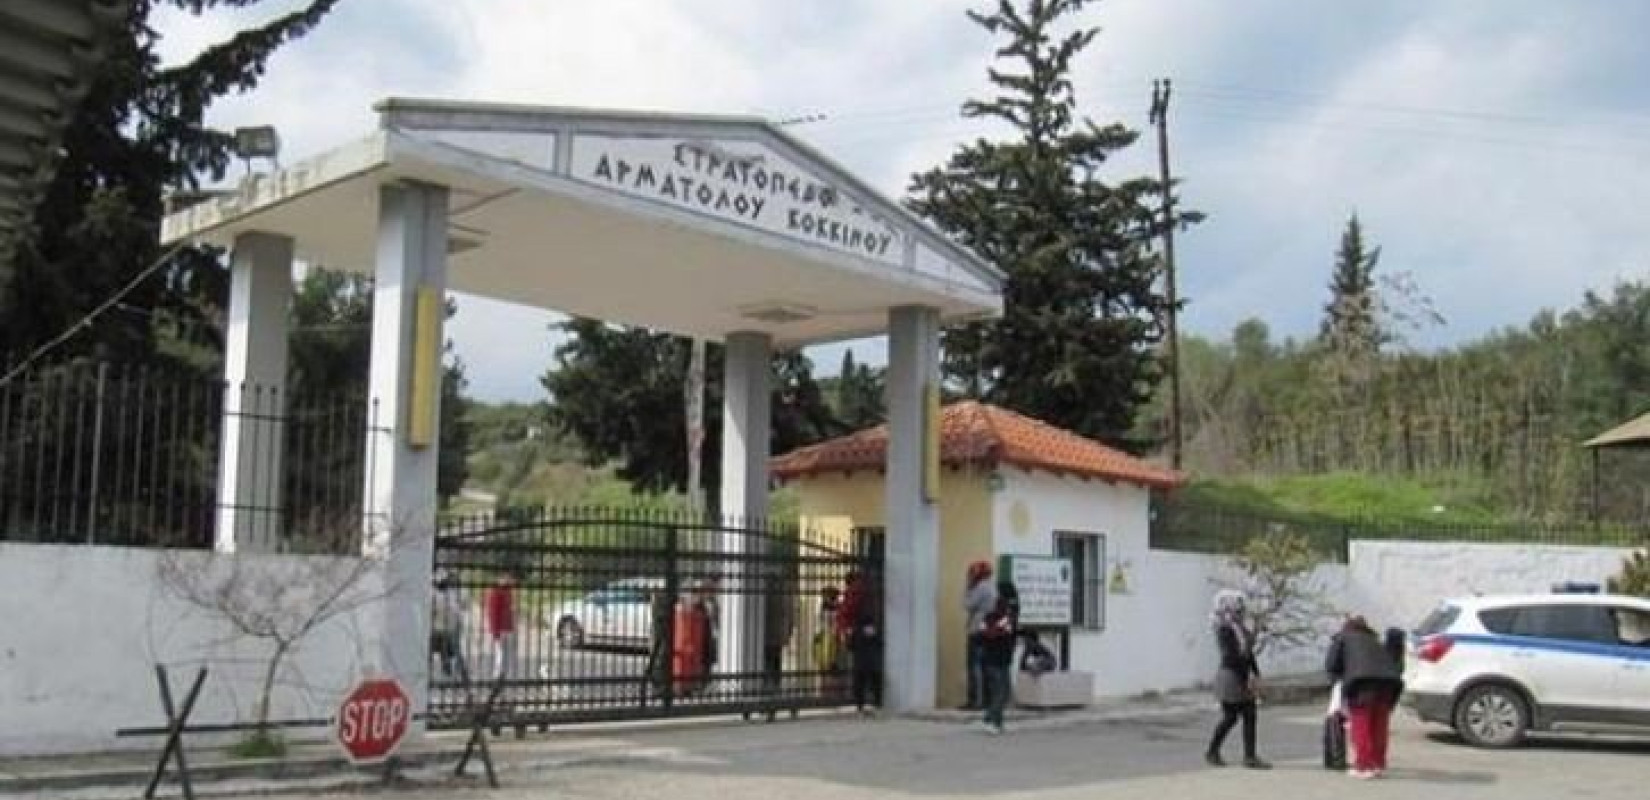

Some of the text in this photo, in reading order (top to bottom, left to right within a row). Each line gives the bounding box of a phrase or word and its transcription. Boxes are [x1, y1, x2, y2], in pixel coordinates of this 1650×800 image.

[594, 153, 892, 255] ΑΡΜΑΤΟΛΟΥ ΚΟΚΚΙΝΟΥ
[342, 697, 403, 743] STOP
